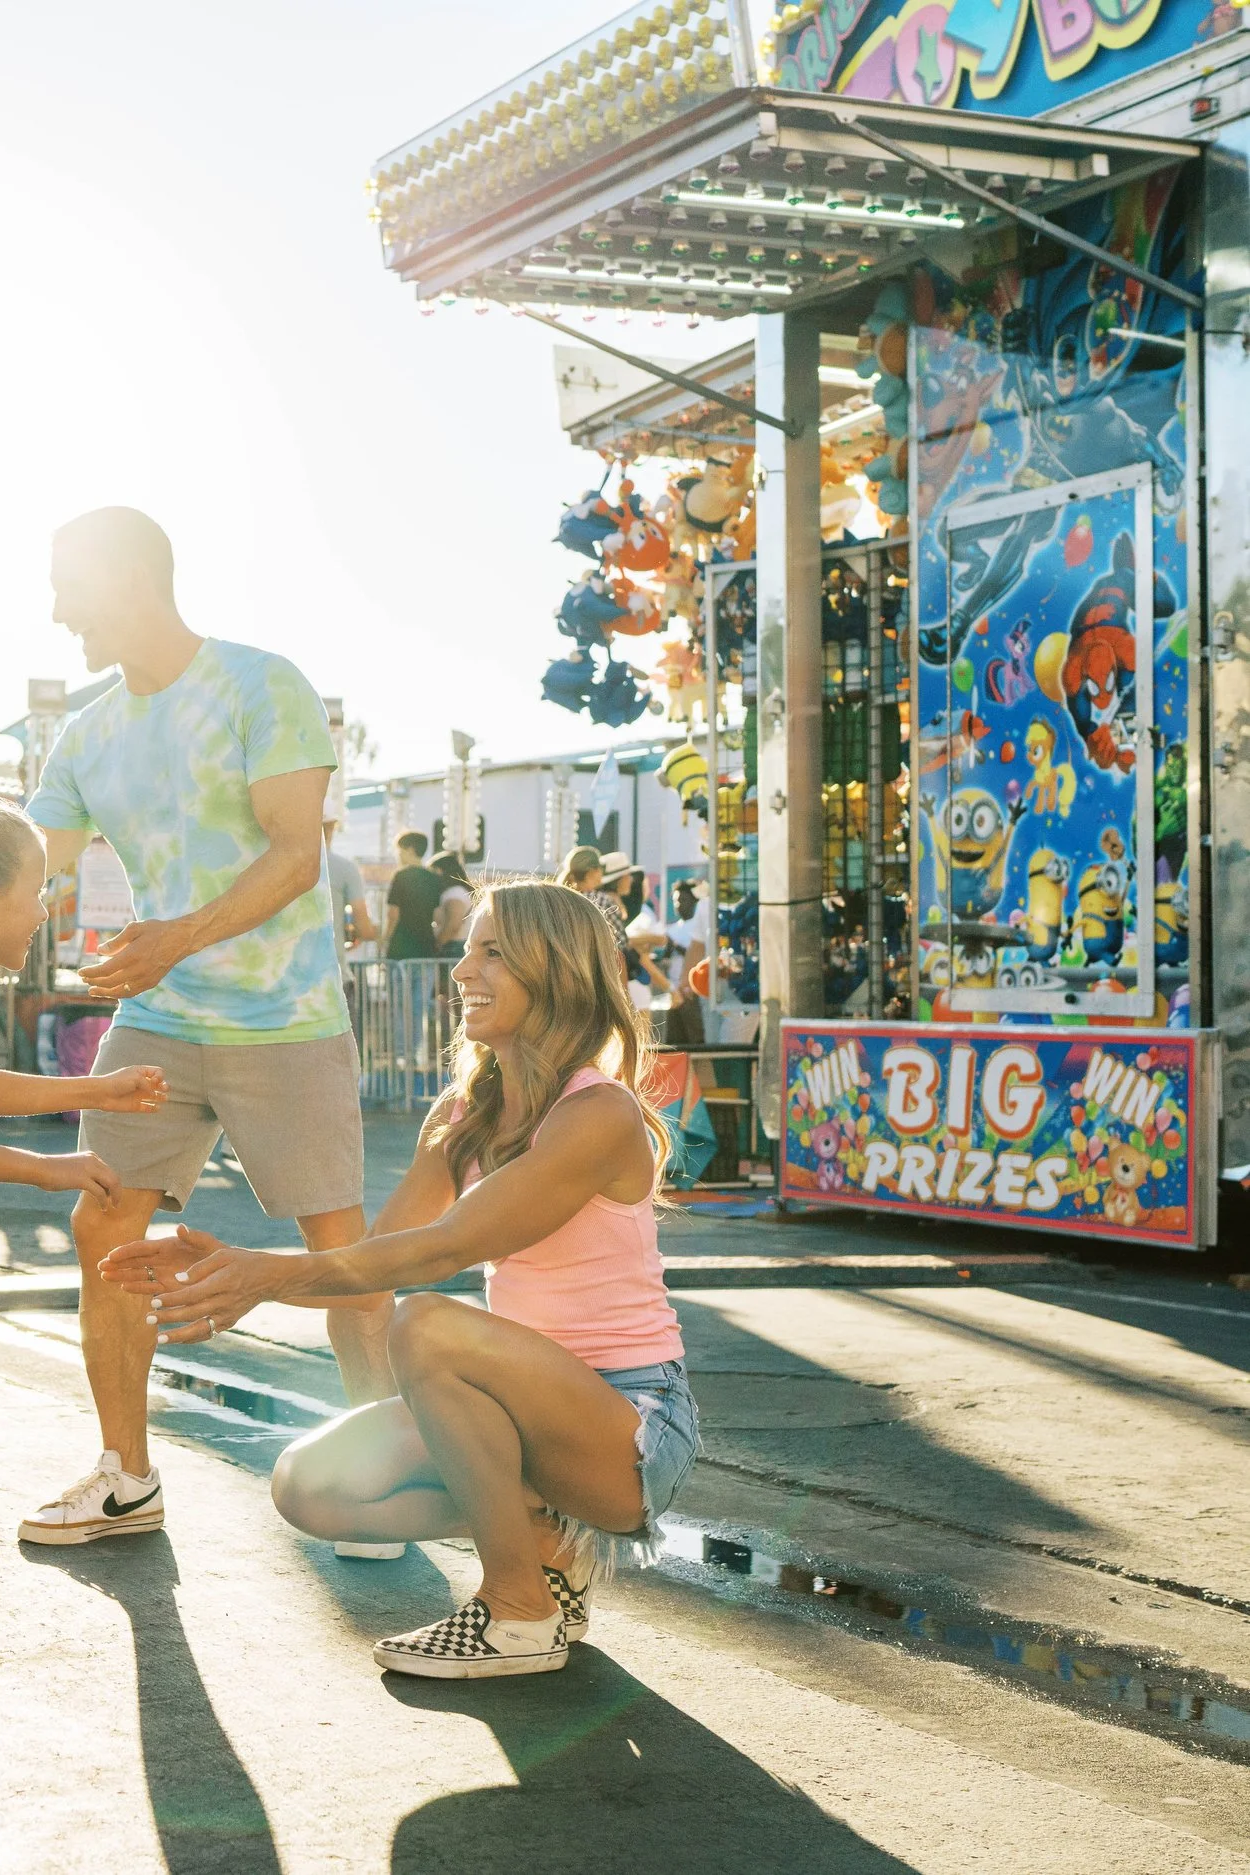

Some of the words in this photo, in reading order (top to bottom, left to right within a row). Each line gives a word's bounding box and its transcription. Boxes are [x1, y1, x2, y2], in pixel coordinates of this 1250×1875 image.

[805, 1039, 862, 1110] WIN
[883, 1045, 1046, 1140] BIG
[1082, 1047, 1161, 1128] WIN
[861, 1141, 1069, 1211] PRIZES
